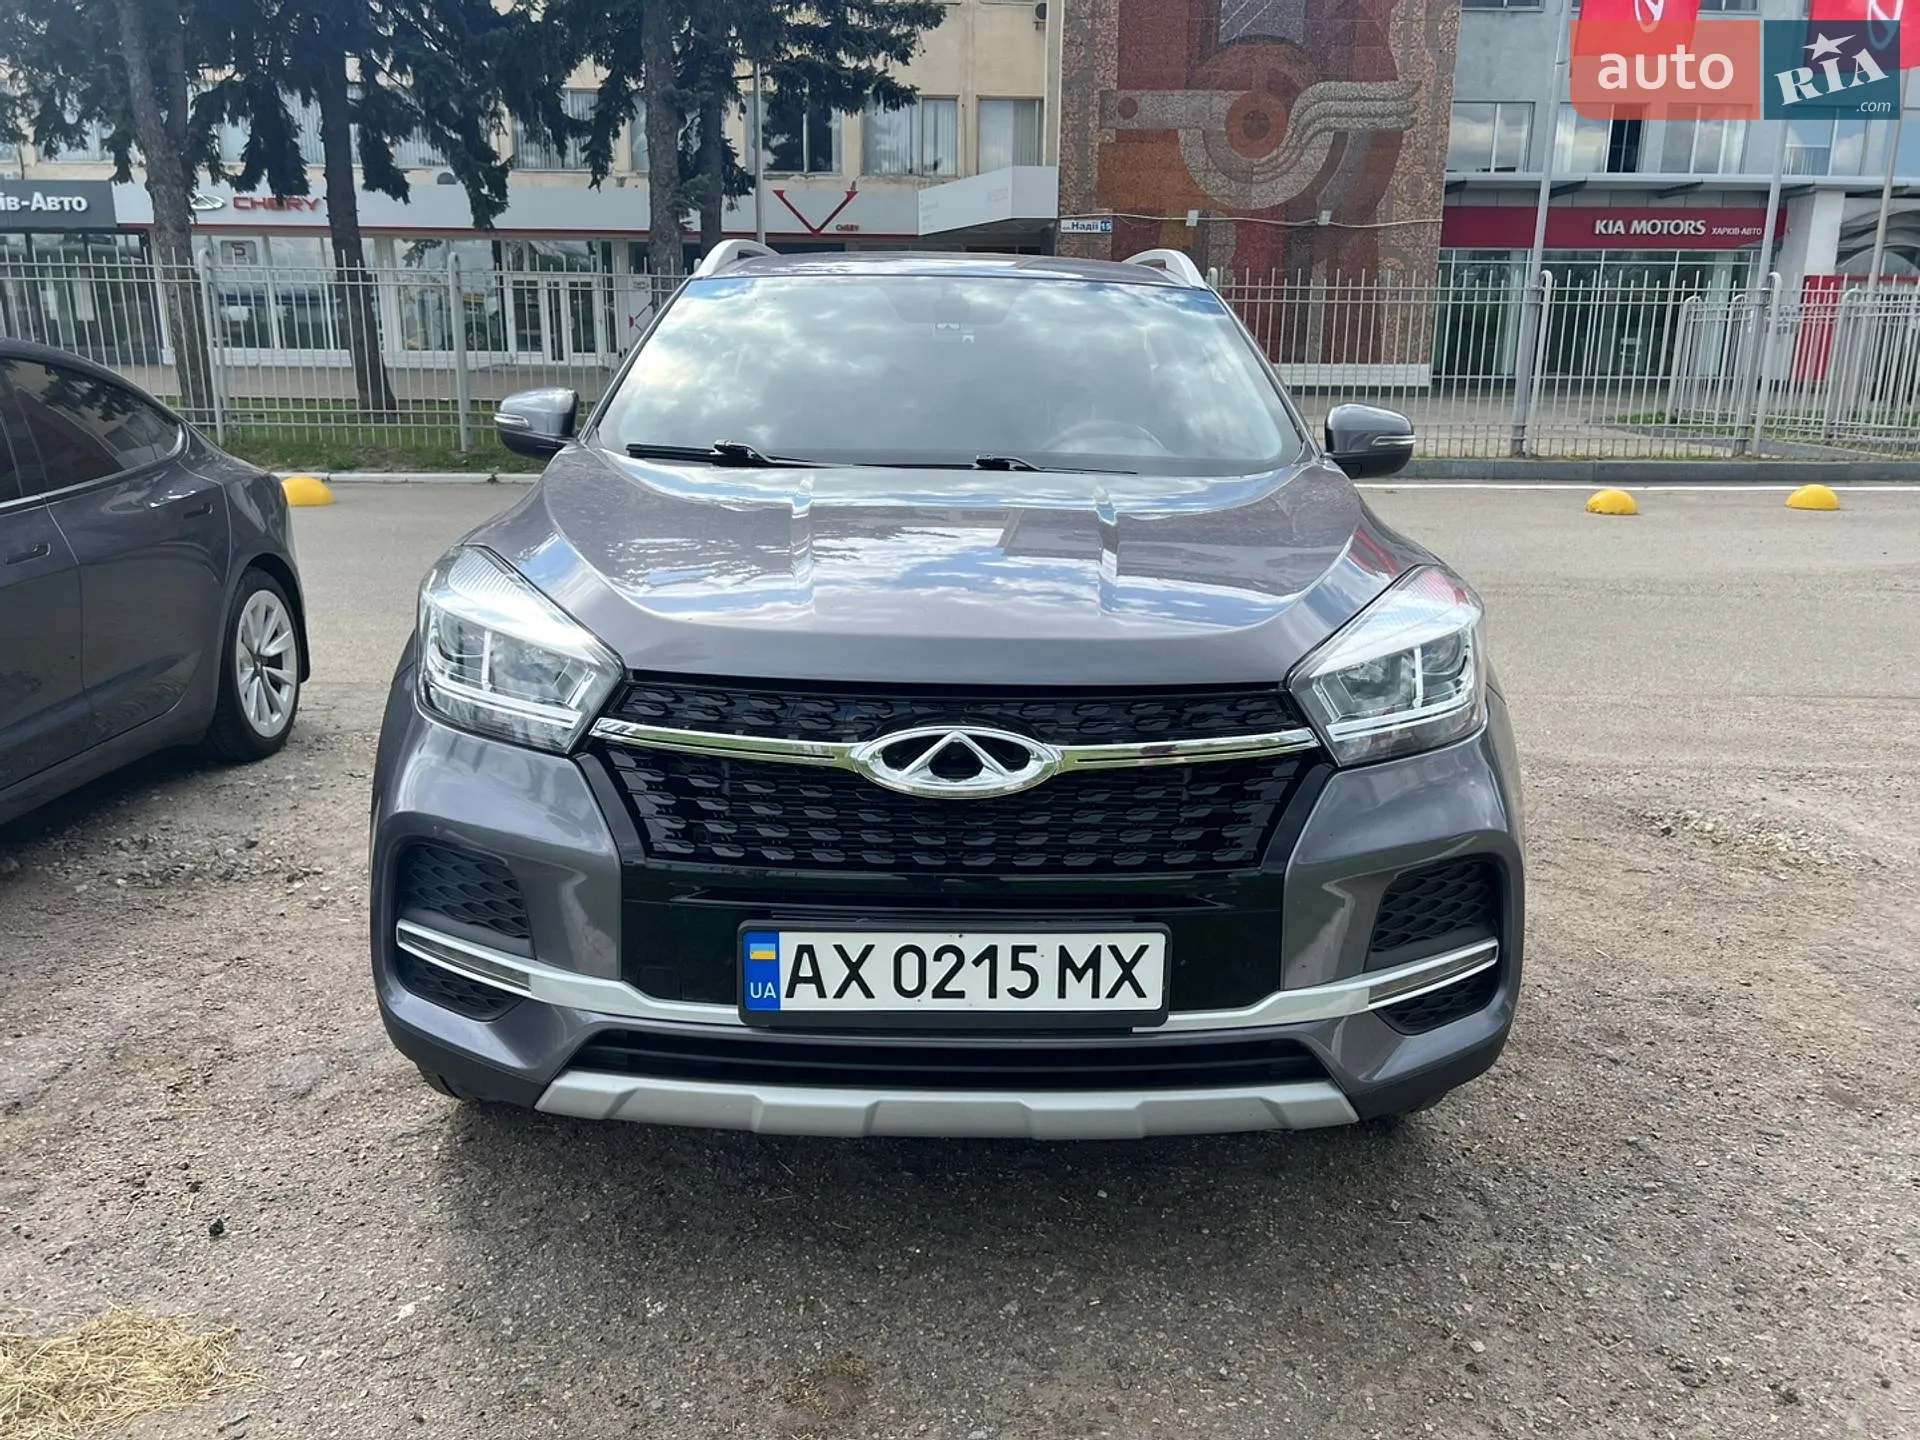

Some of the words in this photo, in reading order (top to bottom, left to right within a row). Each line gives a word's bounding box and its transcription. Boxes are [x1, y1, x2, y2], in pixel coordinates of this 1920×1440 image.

[233, 196, 319, 211] CHERY
[1595, 219, 1625, 235] KIA
[1630, 219, 1706, 235] MOTORS
[785, 944, 876, 999] AX
[892, 944, 1040, 1000] 0215
[1057, 944, 1150, 999] MX
[750, 982, 776, 999] UA
